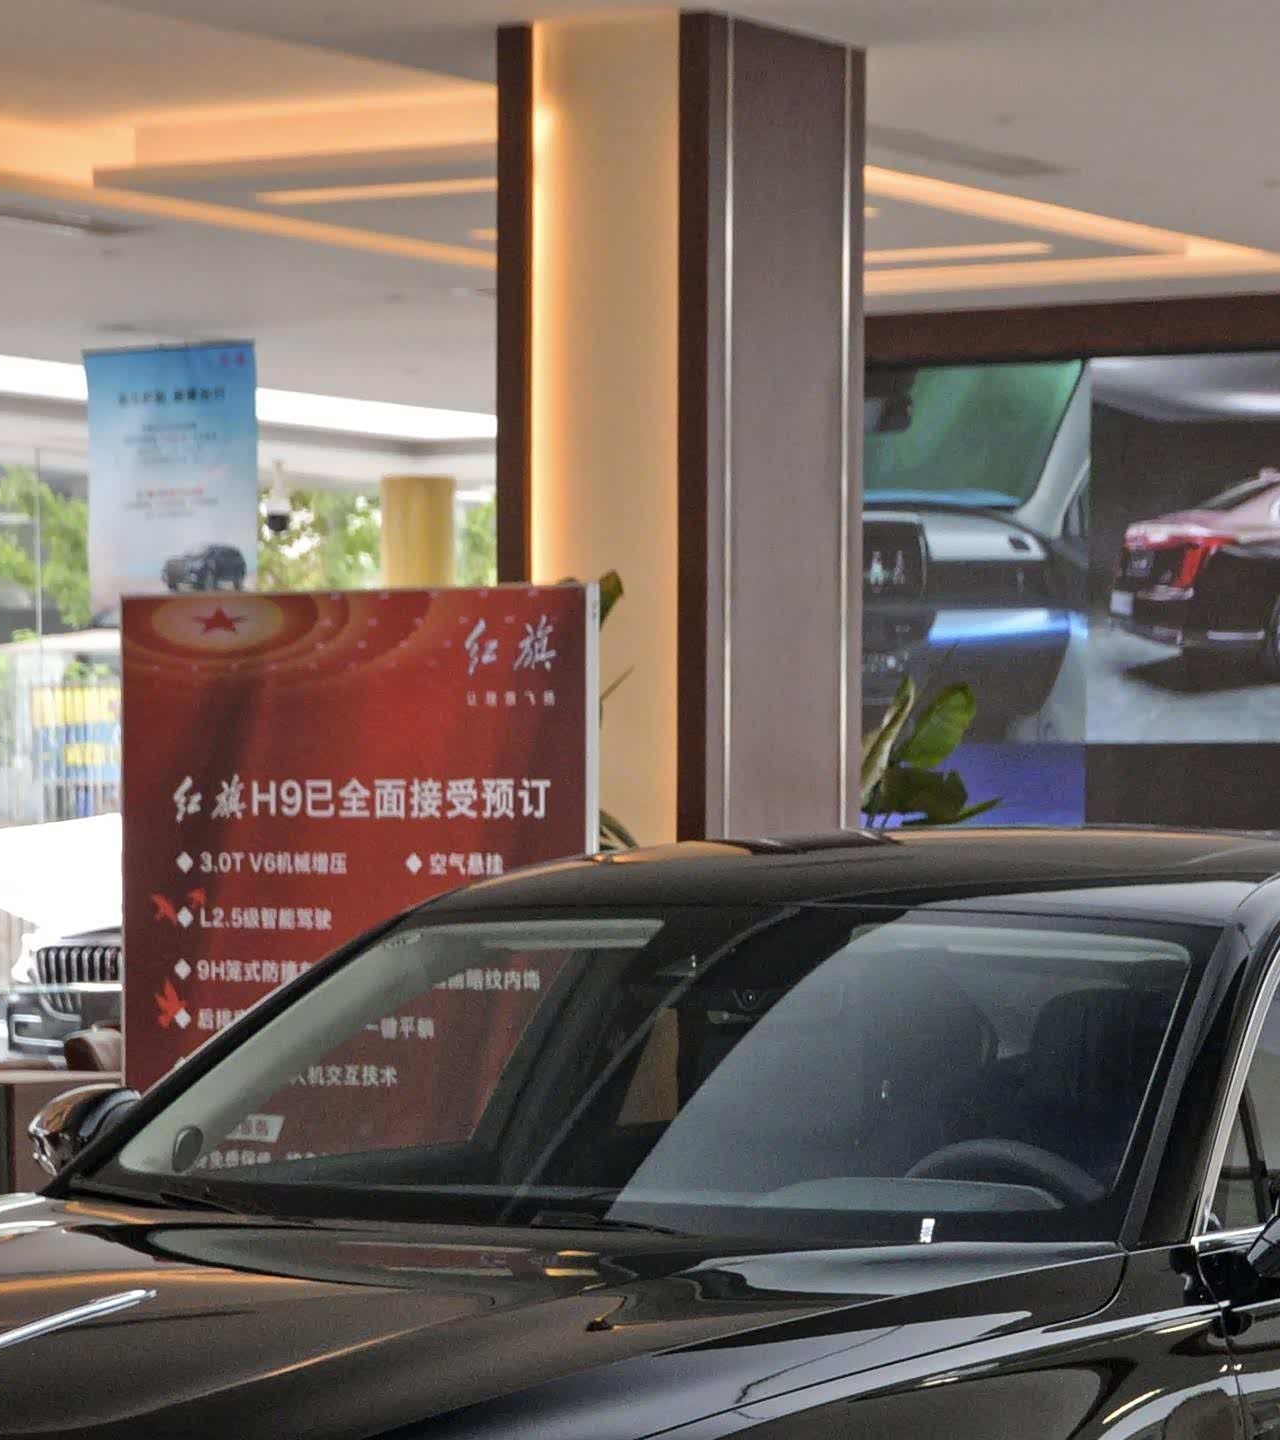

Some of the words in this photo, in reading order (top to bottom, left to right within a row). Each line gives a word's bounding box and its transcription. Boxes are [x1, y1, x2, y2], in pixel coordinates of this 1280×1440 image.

[173, 774, 551, 822] 红旗H9已全面接受预订
[199, 907, 333, 930] L2.5级智能驾驶
